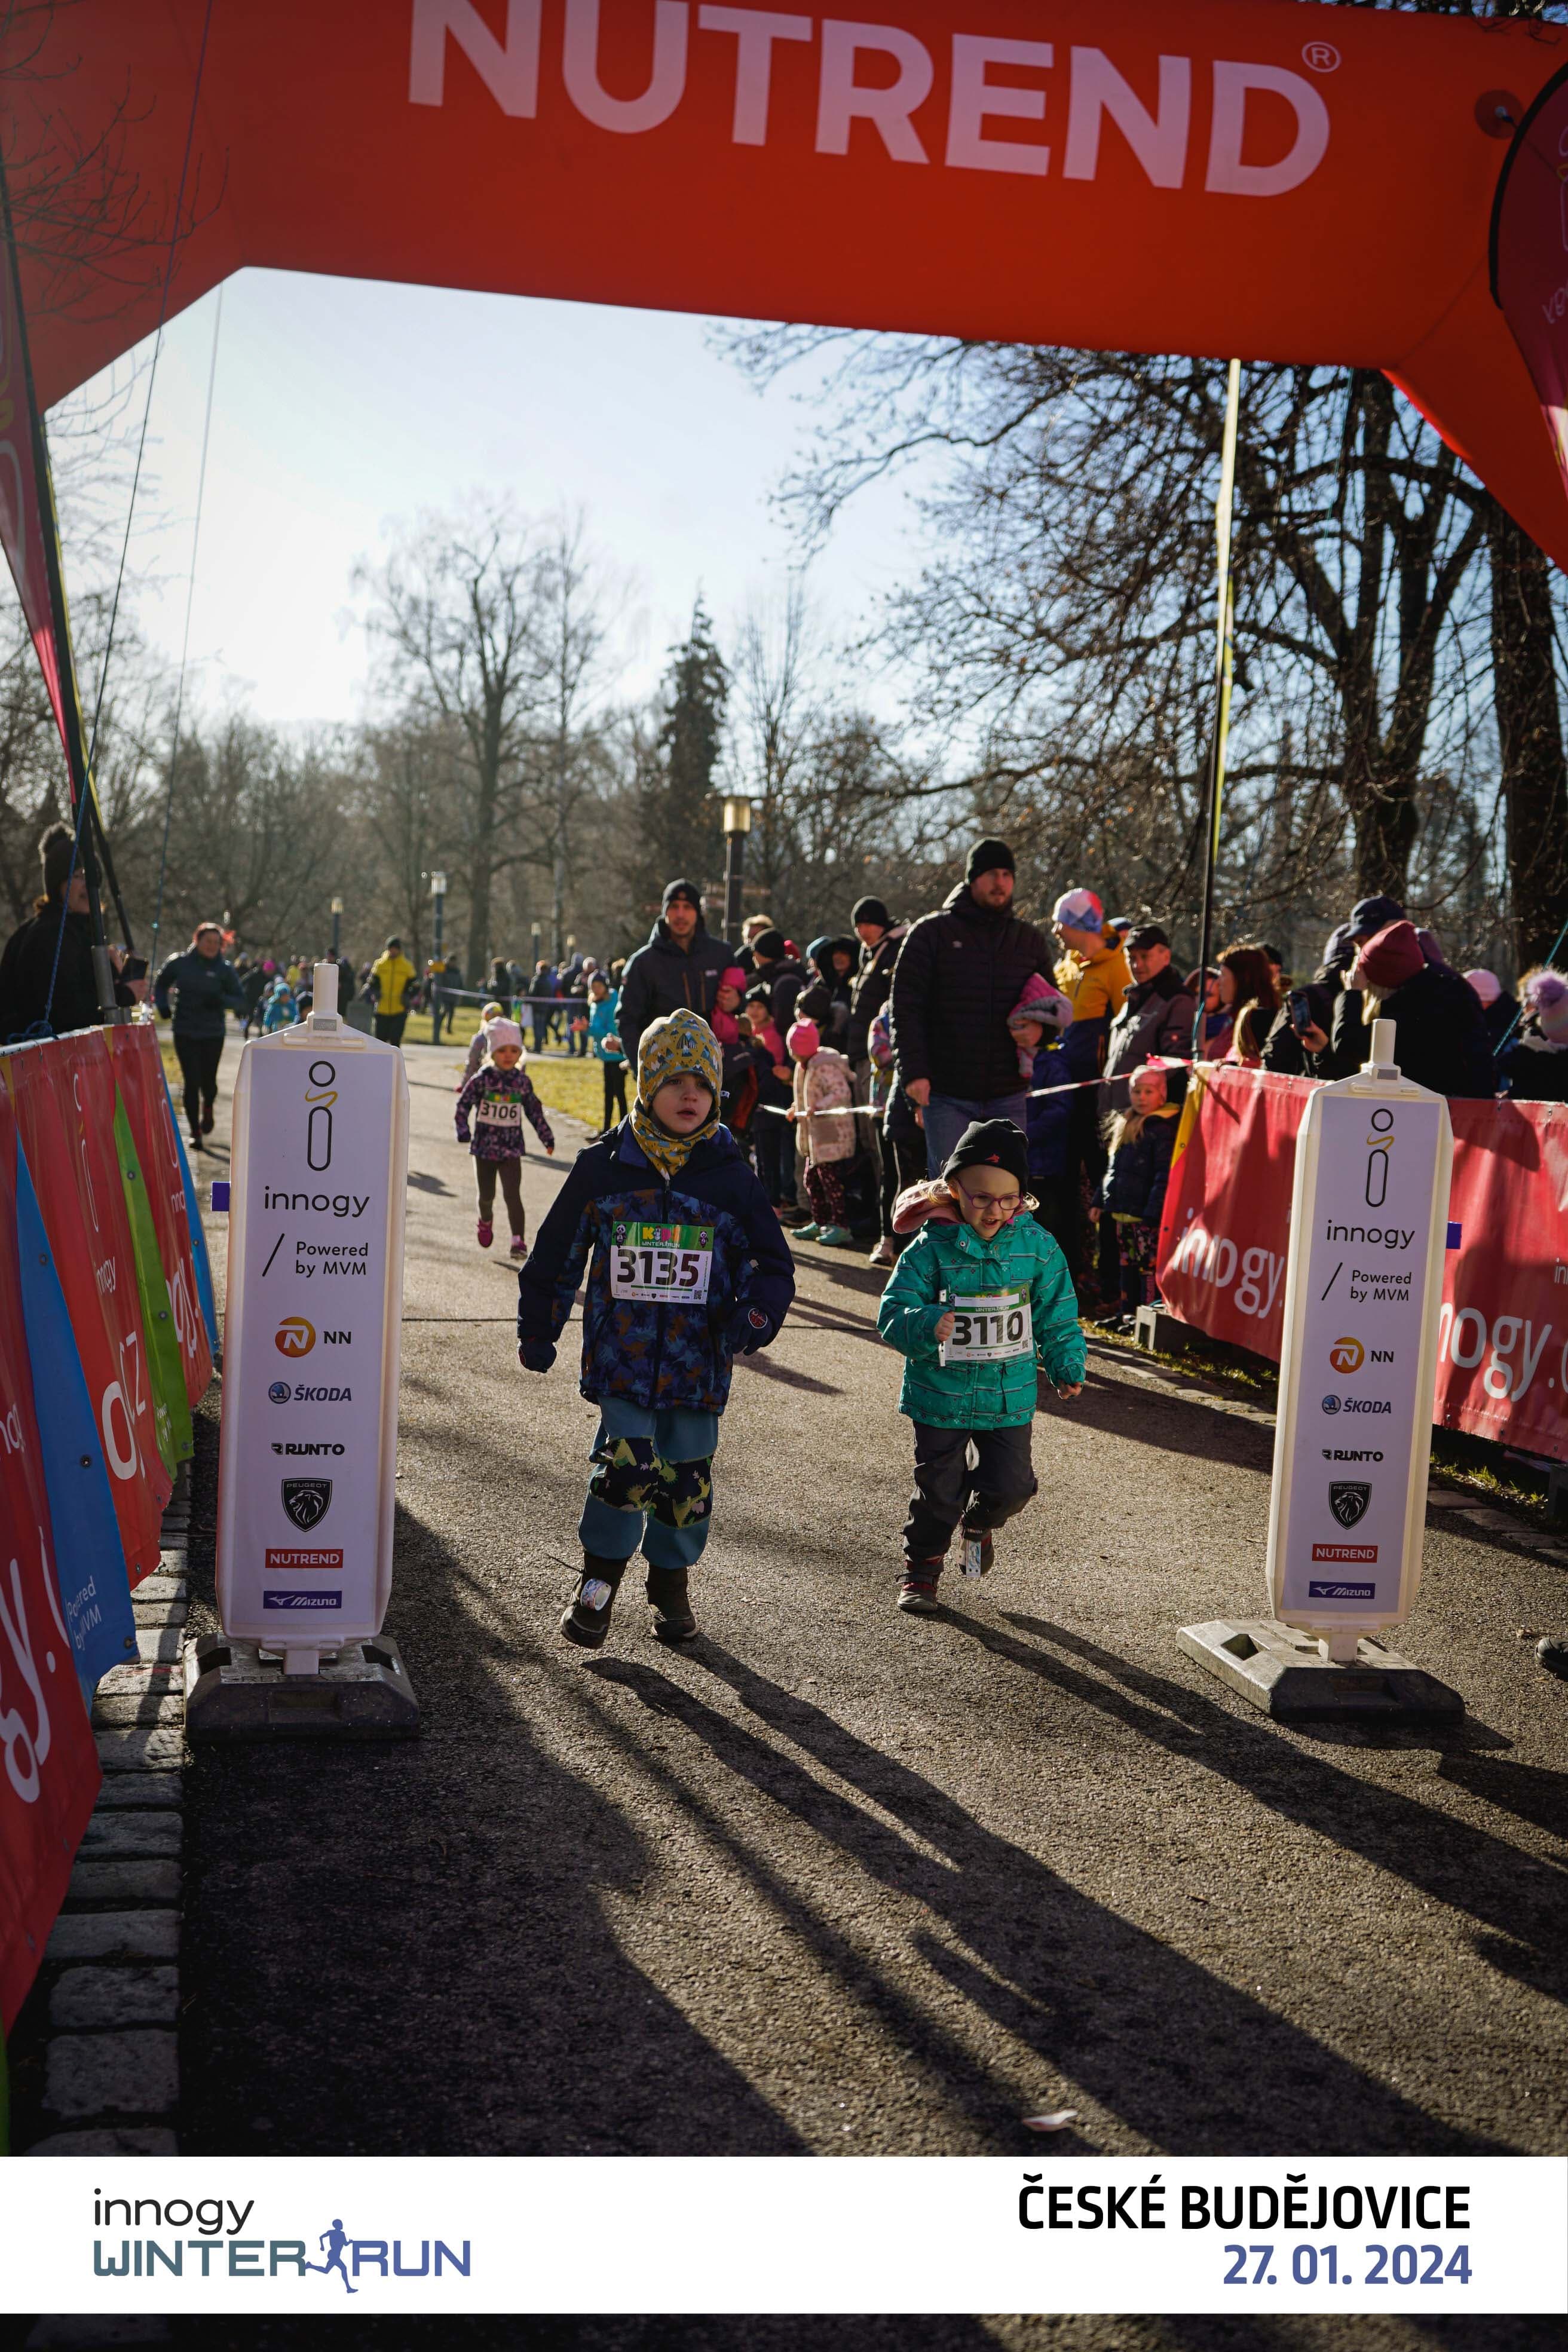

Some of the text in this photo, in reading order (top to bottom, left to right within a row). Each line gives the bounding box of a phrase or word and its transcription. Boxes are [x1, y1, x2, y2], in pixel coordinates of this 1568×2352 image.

[408, 0, 1330, 197] NUTREND
[481, 1101, 517, 1119] 3106
[265, 1186, 370, 1218] innogy
[1327, 1219, 1416, 1250] innogy
[296, 1241, 369, 1257] Powered
[295, 1259, 366, 1278] by MVM
[617, 1249, 700, 1287] 3135
[1352, 1269, 1412, 1285] Powered
[1350, 1286, 1409, 1303] by MVM
[952, 1311, 1023, 1346] 3110
[323, 1331, 351, 1345] NN
[1370, 1350, 1394, 1363] NN
[293, 1384, 352, 1401] ŠKODA
[1343, 1397, 1392, 1414] ŠKODA
[285, 1443, 345, 1456] RUNTO
[1333, 1450, 1384, 1462] RUNTO
[270, 1553, 339, 1564] NUTREND
[1316, 1548, 1374, 1559] NUTREND
